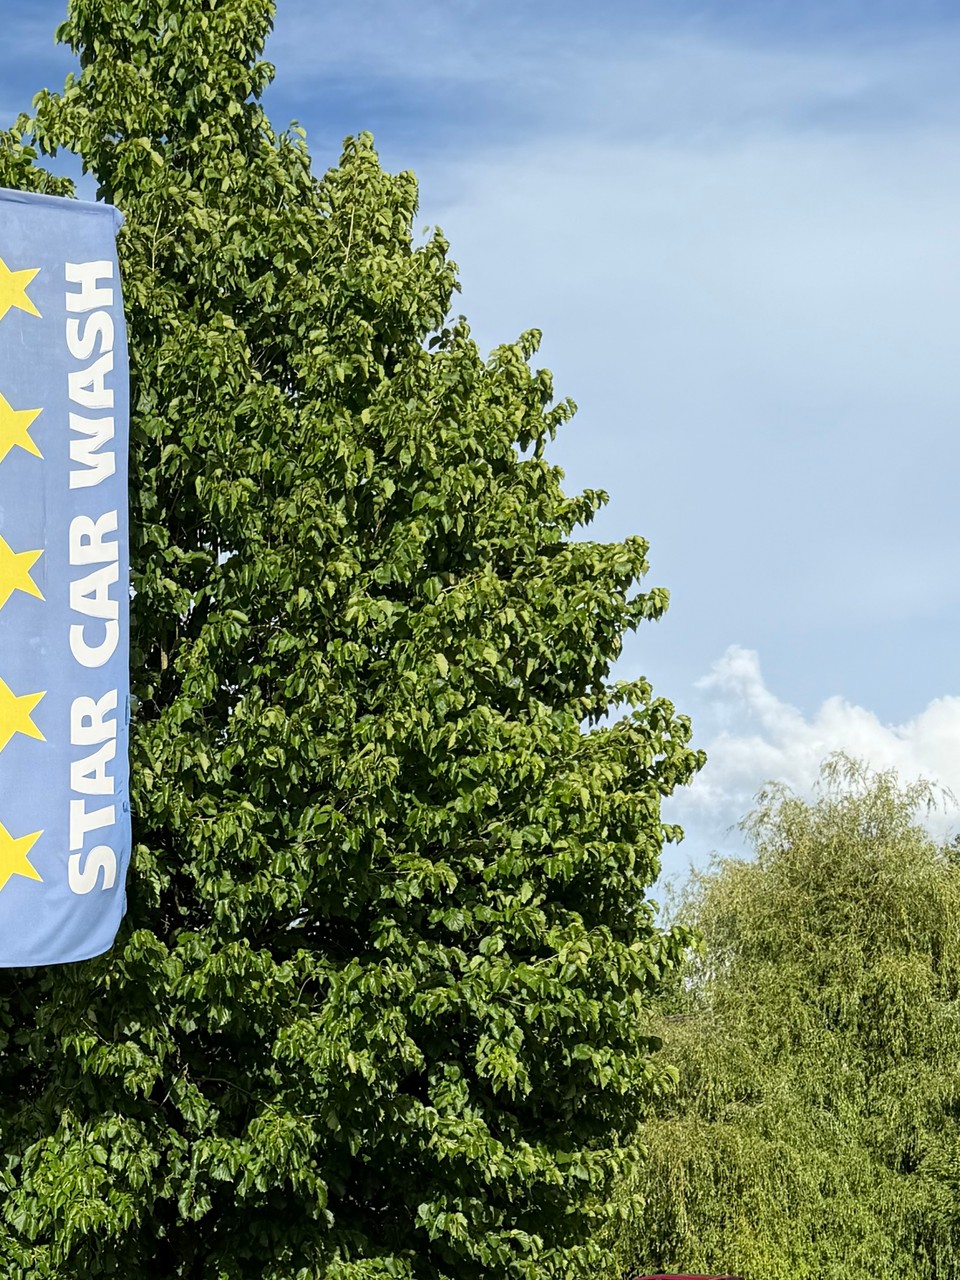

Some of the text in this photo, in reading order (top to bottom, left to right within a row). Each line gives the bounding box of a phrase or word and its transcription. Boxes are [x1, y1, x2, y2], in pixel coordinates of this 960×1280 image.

[65, 260, 119, 895] STAR CAR WASH
